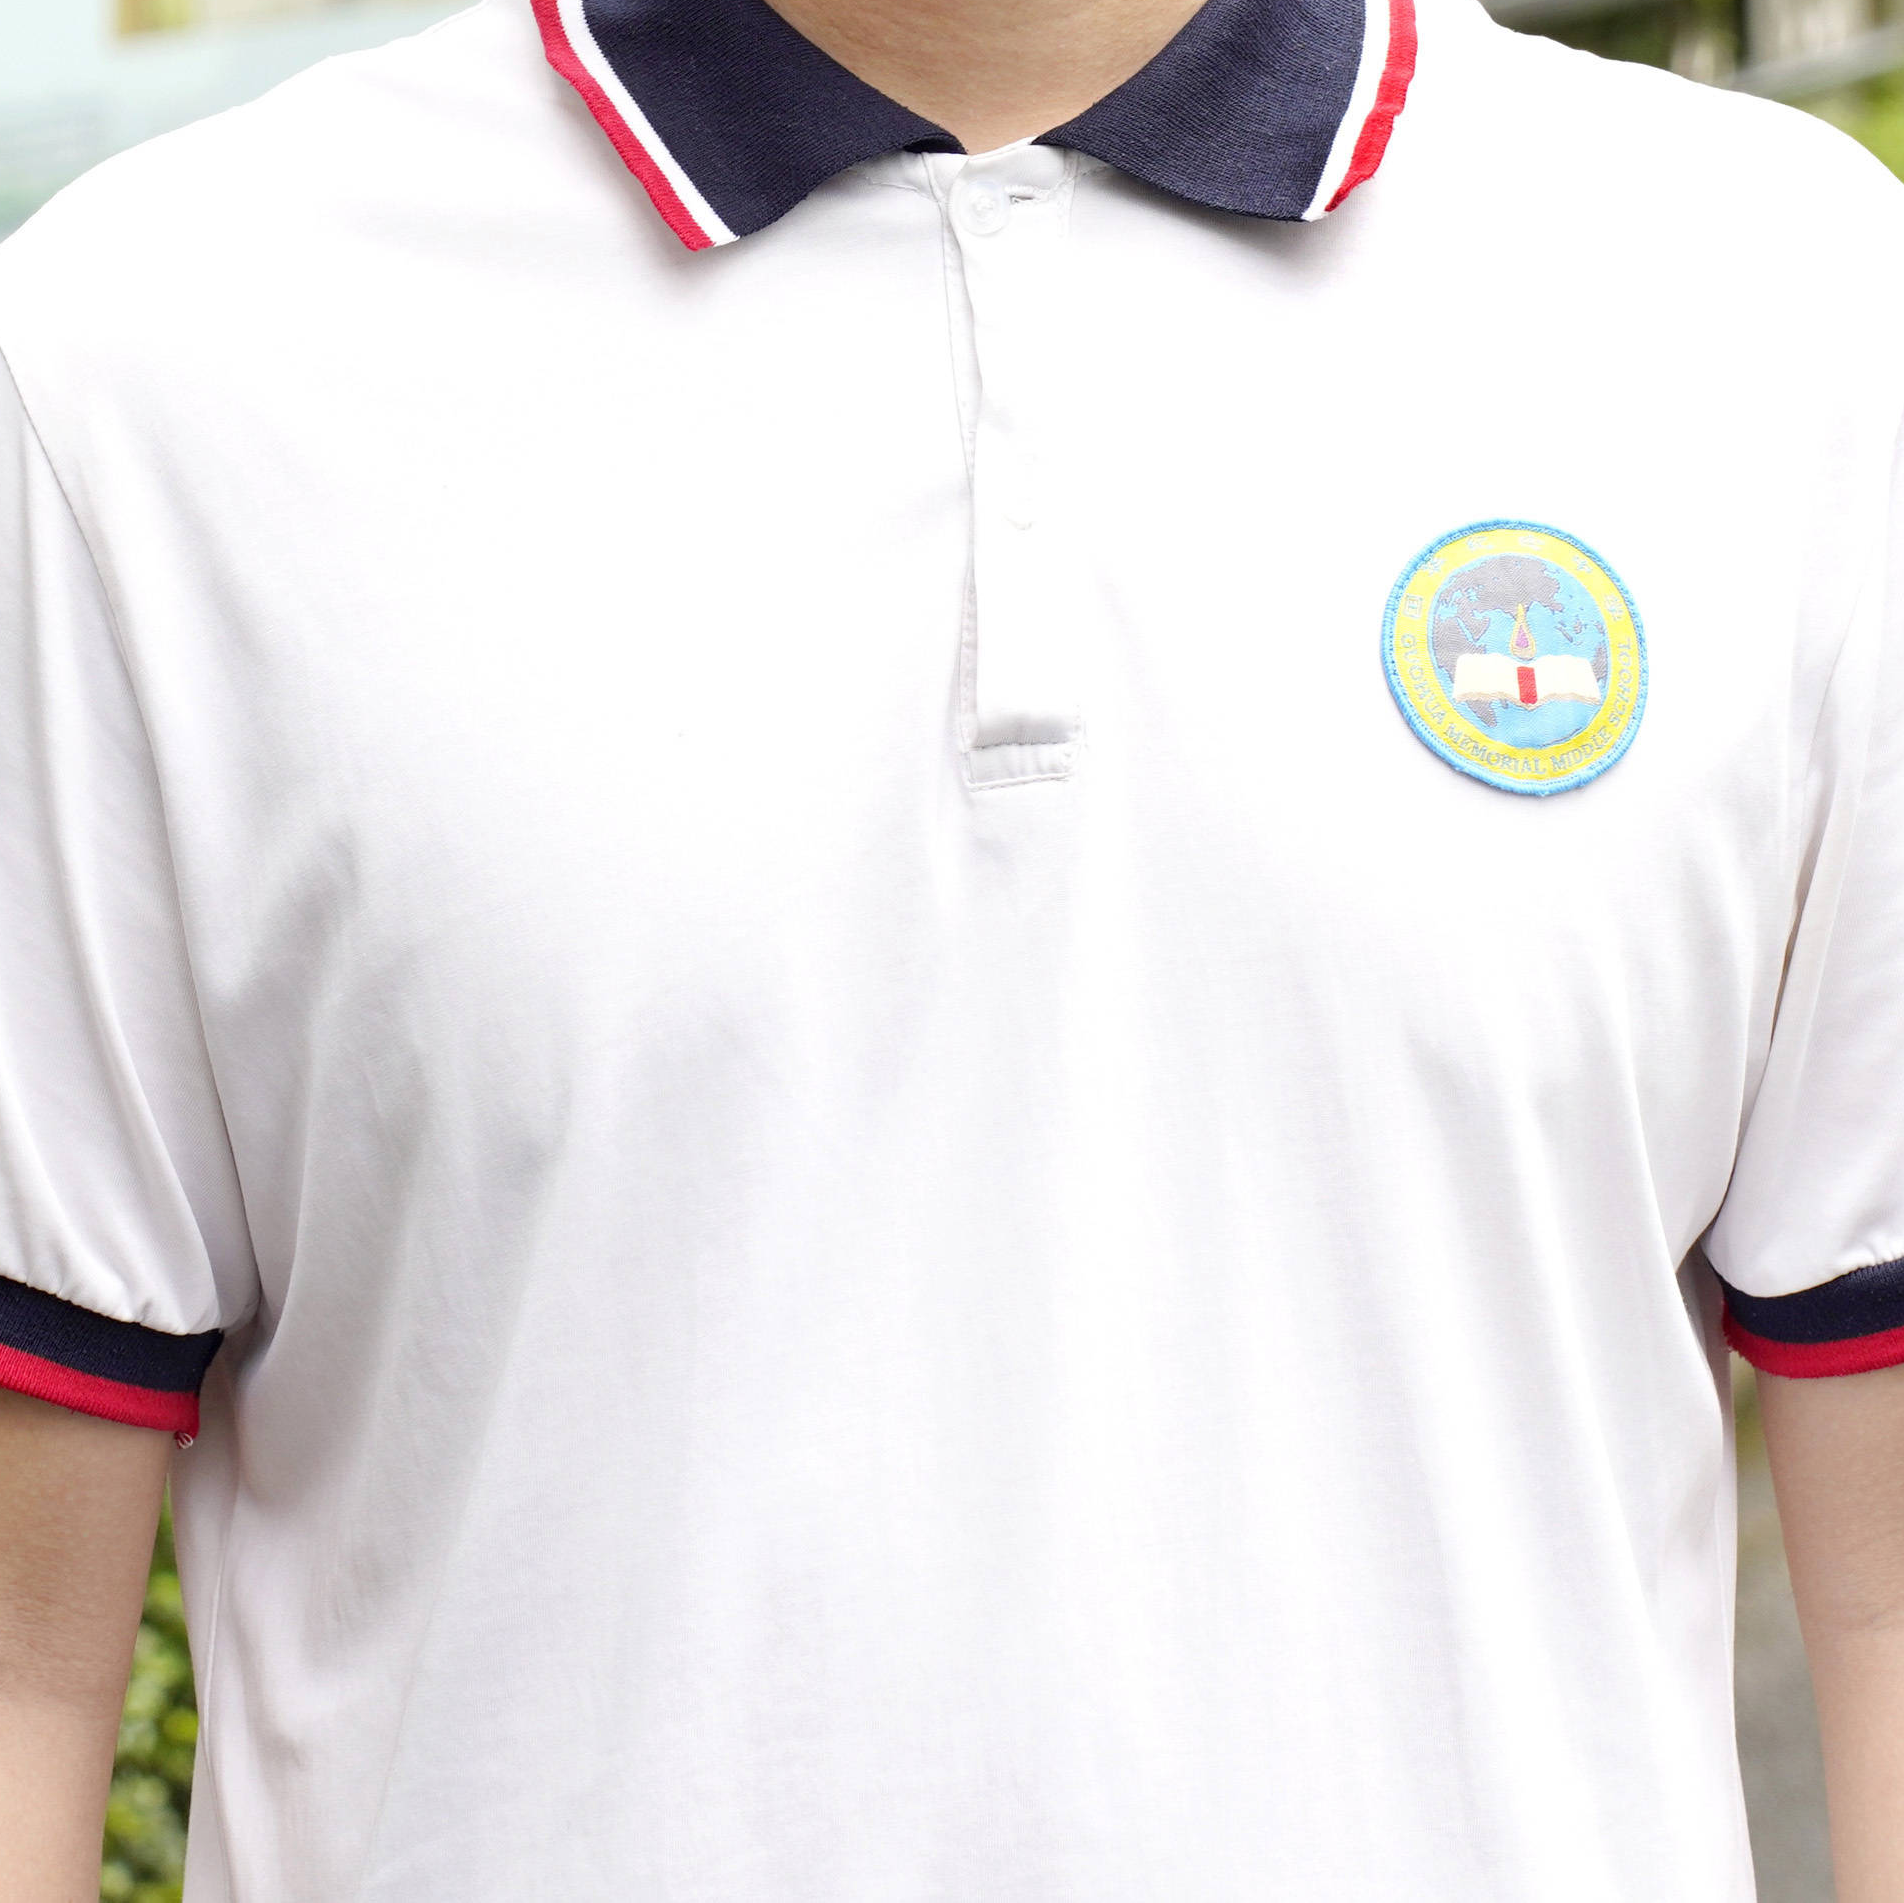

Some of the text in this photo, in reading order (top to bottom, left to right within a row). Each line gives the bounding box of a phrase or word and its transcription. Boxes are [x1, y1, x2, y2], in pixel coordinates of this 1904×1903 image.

[1400, 633, 1633, 776] GUOHUA MEMORIAL MIDDLE SCHOOL
